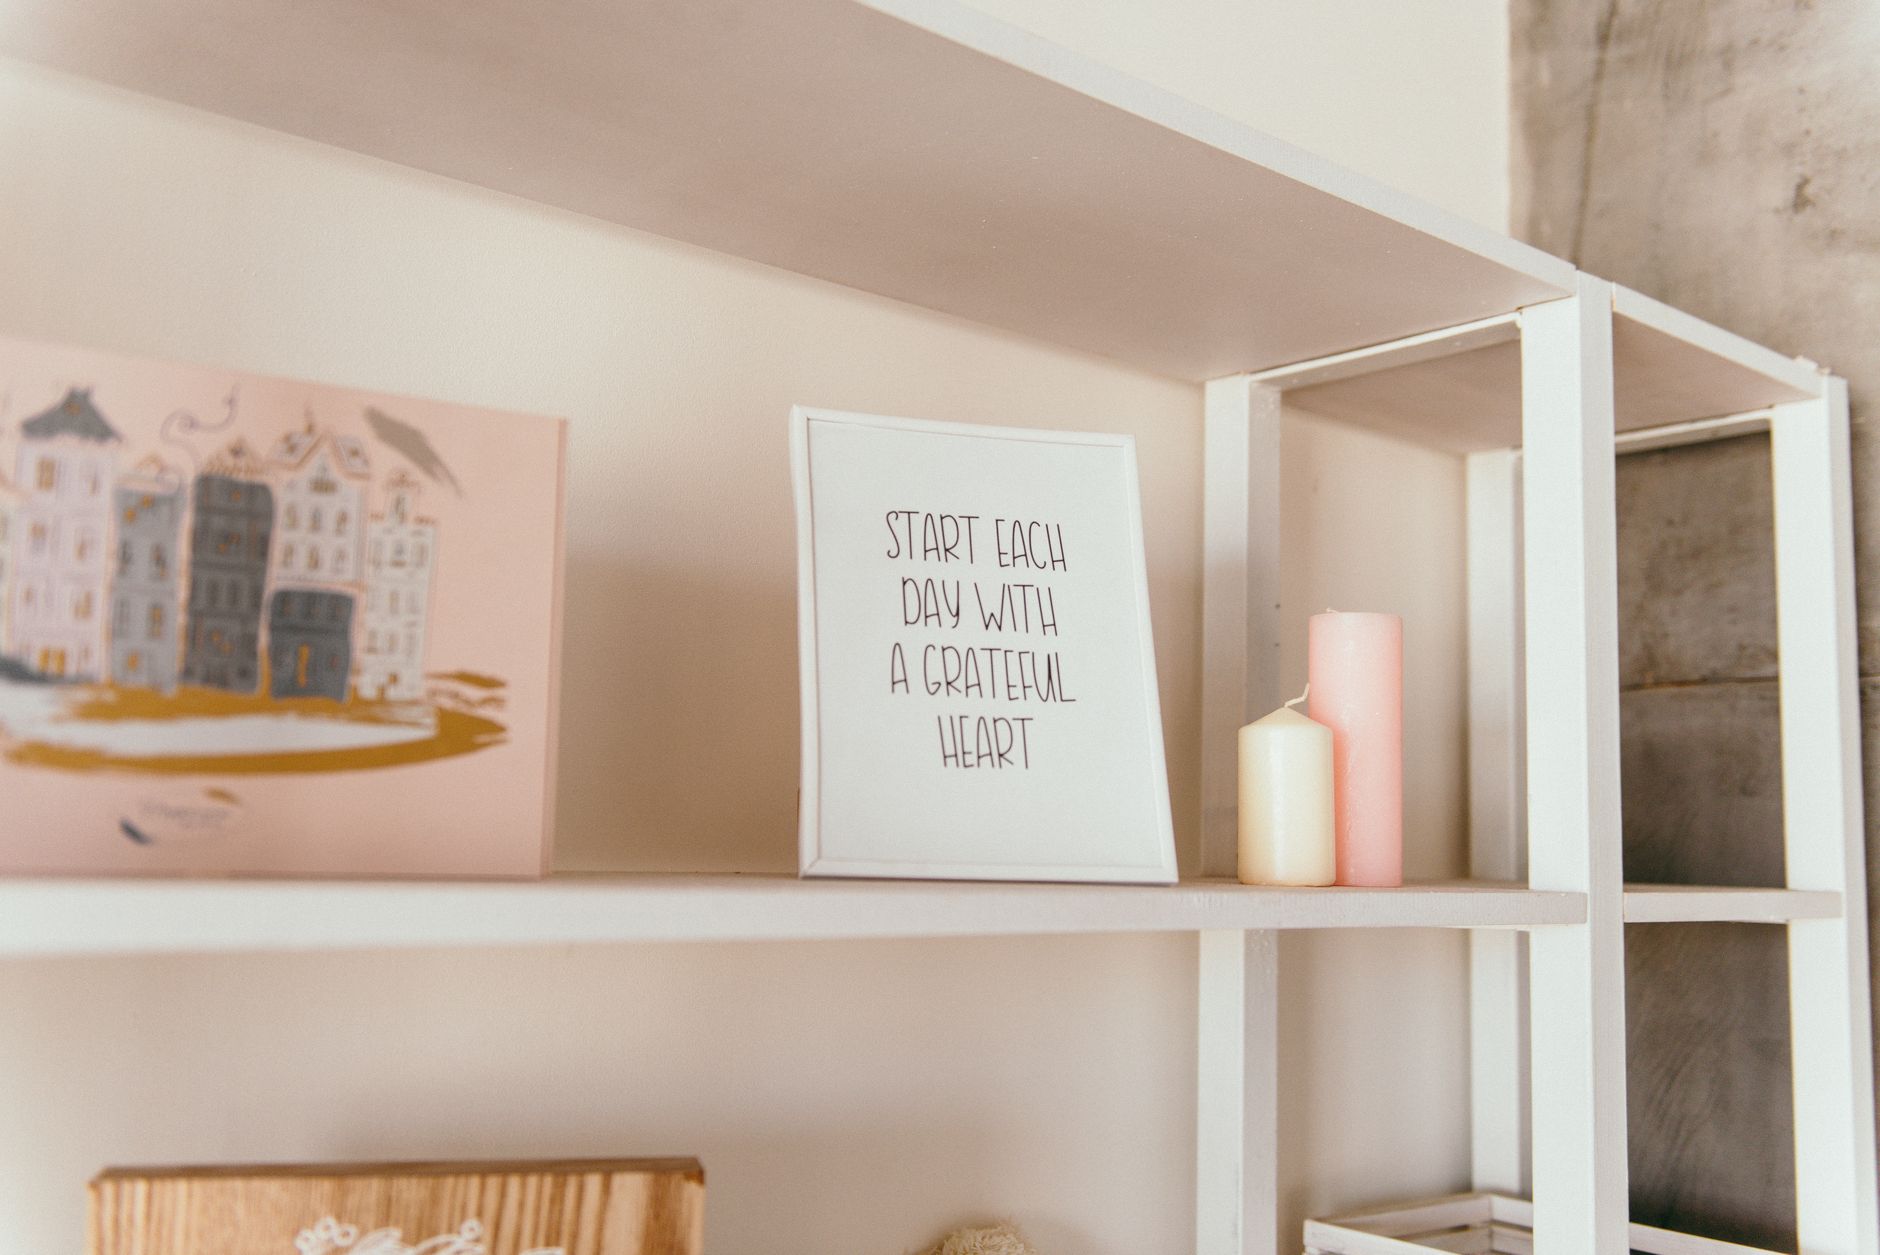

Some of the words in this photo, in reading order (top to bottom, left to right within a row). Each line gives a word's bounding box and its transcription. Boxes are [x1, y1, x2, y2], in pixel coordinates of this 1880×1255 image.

[886, 510, 980, 564] START
[995, 518, 1067, 572] EACH
[902, 577, 960, 629] DAY
[974, 582, 1058, 636] WITH
[891, 642, 910, 694] A
[923, 644, 1077, 703] GRATEFUL
[937, 715, 1034, 769] HEART
